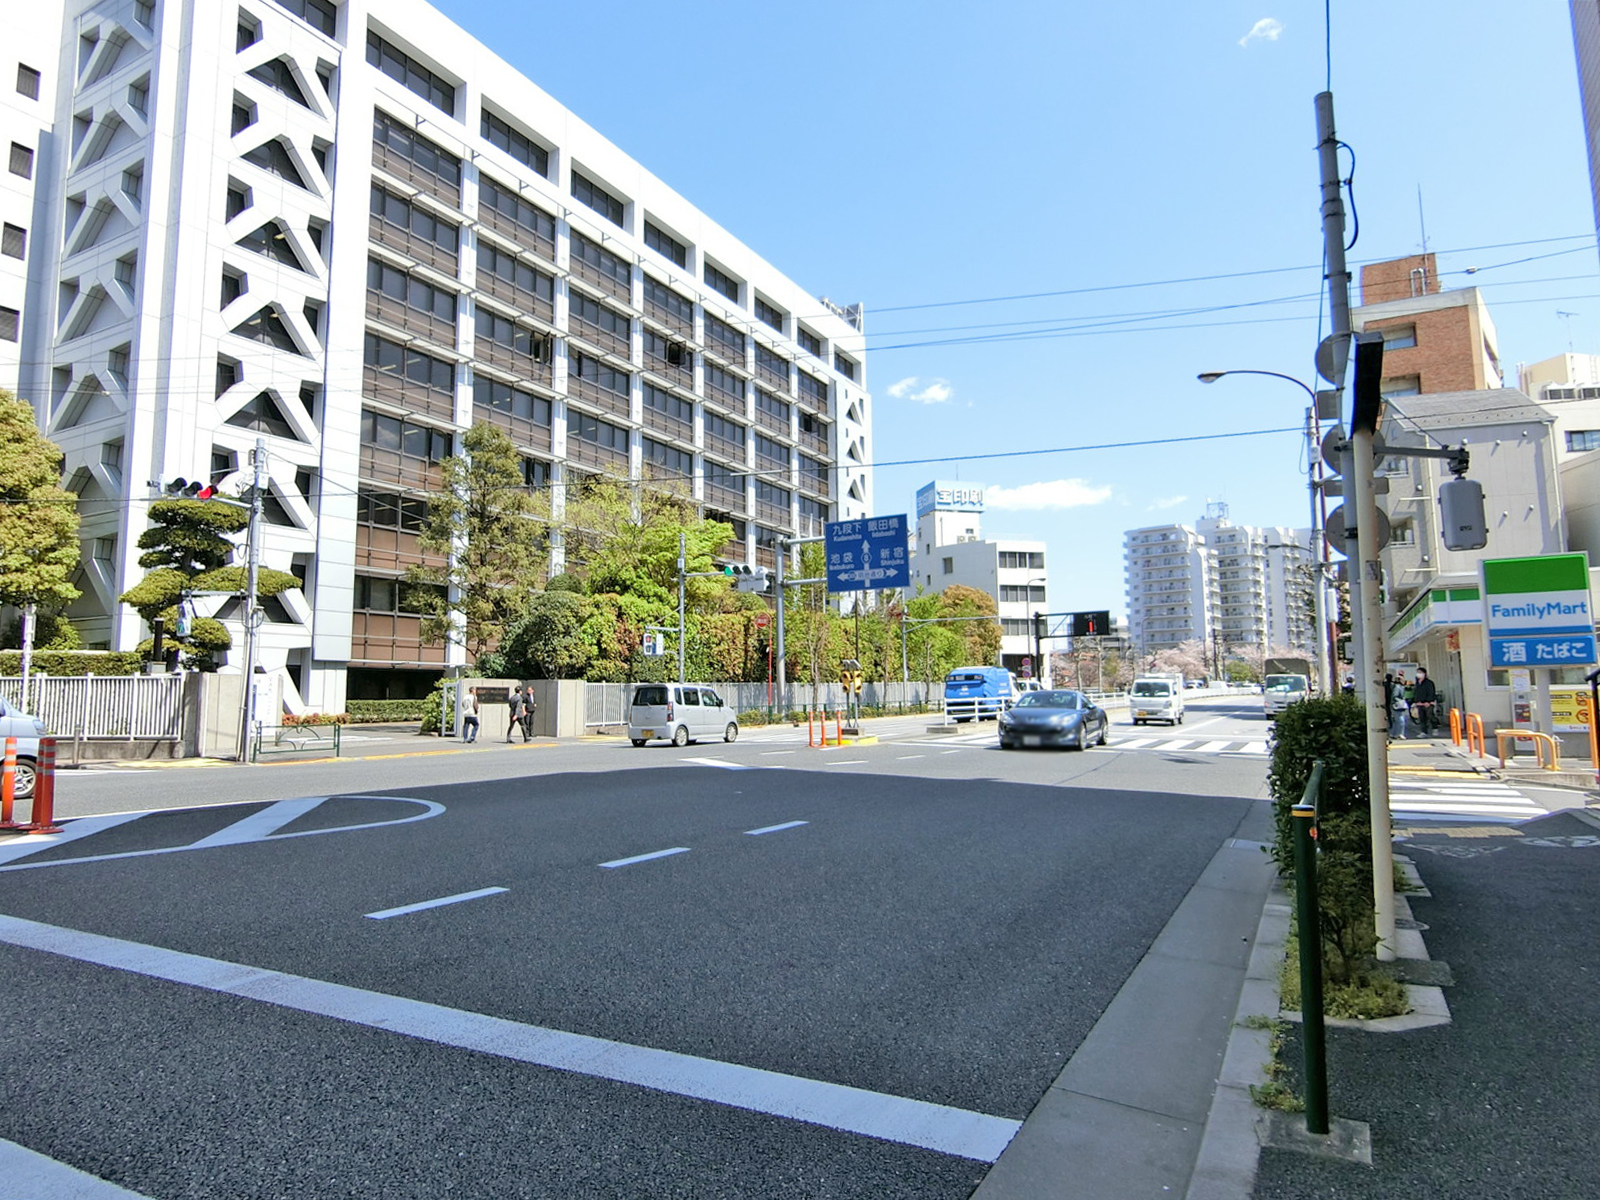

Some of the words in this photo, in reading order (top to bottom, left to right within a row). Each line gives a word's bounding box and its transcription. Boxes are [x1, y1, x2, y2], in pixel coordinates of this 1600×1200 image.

[936, 488, 983, 506] 宝印刷
[832, 522, 862, 536] 九段下
[867, 518, 899, 532] 飯田橋
[830, 552, 853, 564] 池袋
[880, 547, 904, 559] 新宿
[1491, 602, 1587, 620] FamilyMart
[1502, 642, 1527, 662] 酒
[1535, 642, 1587, 659] たばこ
